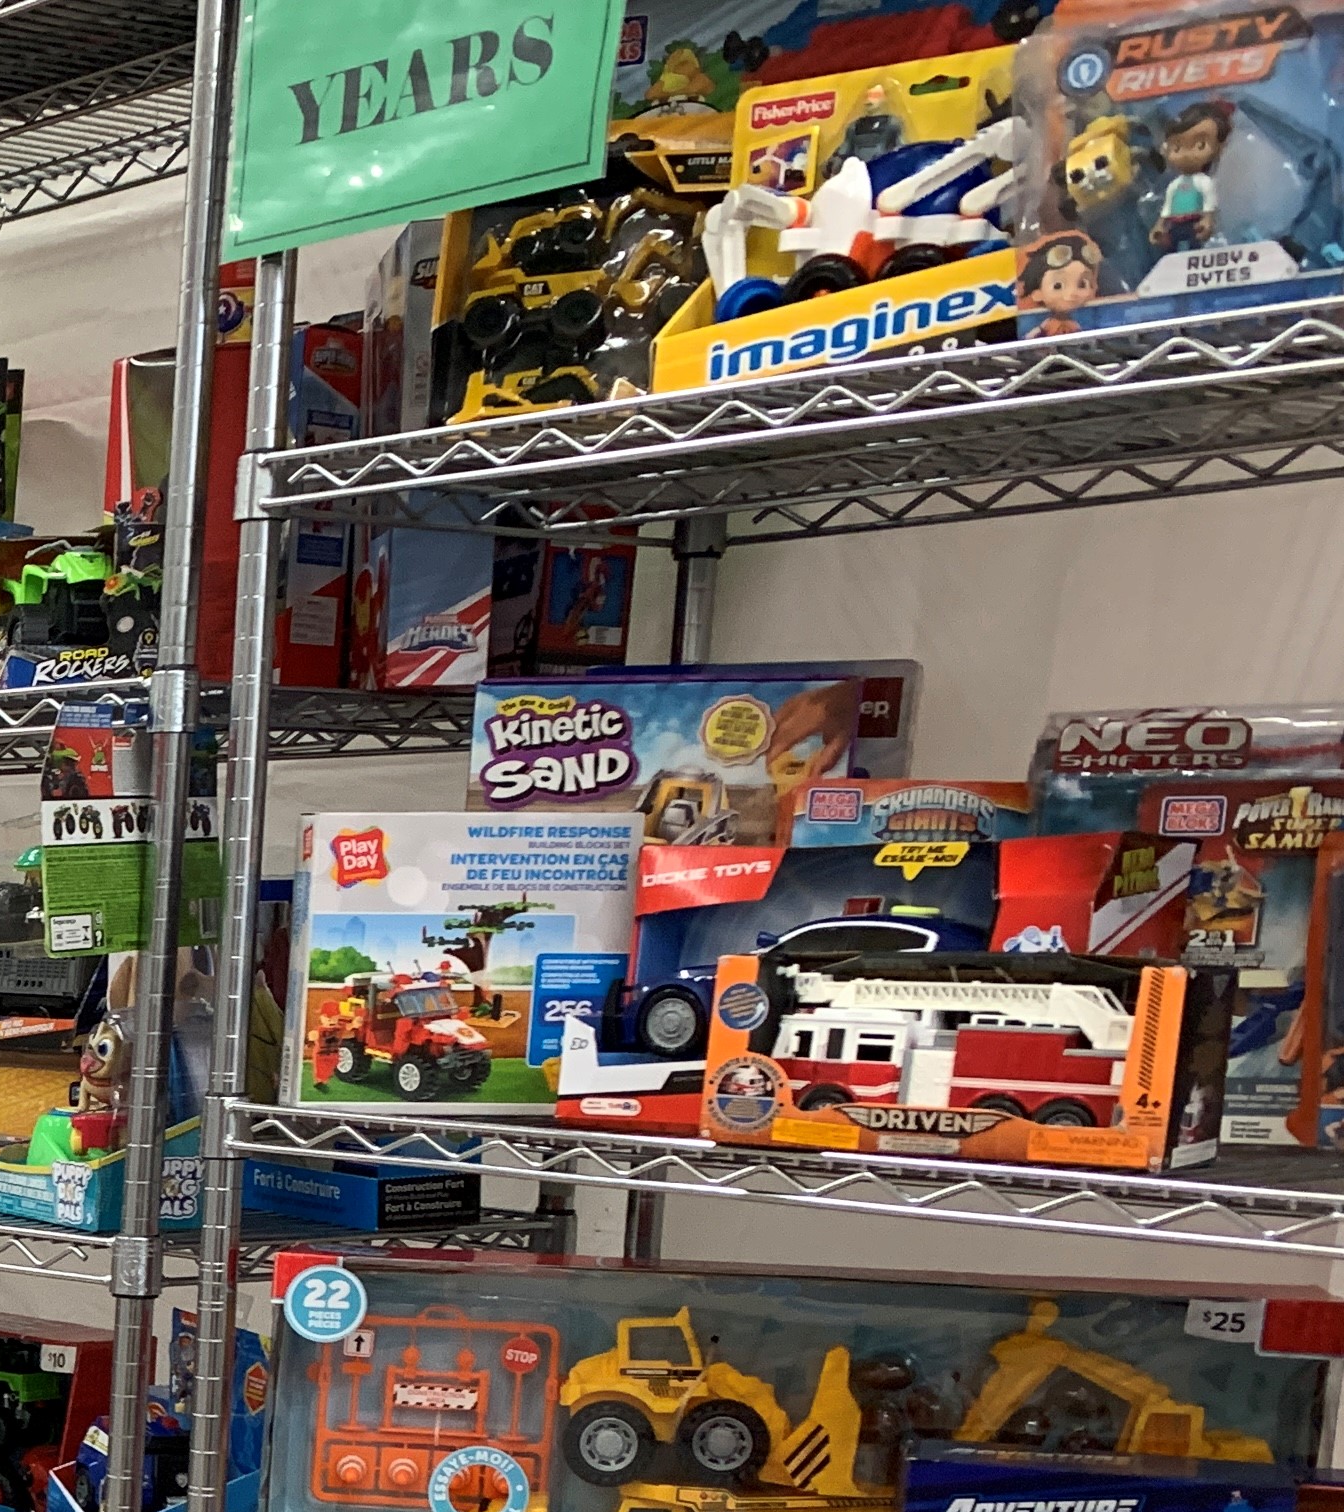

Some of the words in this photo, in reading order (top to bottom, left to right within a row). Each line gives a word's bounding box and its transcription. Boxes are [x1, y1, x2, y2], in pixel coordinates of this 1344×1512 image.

[1115, 12, 1291, 63] RUSTY
[287, 15, 555, 146] YEARS
[1114, 49, 1269, 95] RIVETS
[752, 97, 836, 123] Fisher-Price
[1185, 251, 1242, 271] RUBY
[1185, 266, 1252, 287] BYTES
[522, 282, 547, 296] CAT
[59, 646, 110, 662] ROAD
[33, 654, 131, 686] ROCKERS
[490, 703, 627, 751] Kinetic
[1058, 719, 1247, 753] NEO
[1060, 752, 1247, 768] SHIFTERS
[812, 792, 857, 808] MEGA
[1167, 801, 1220, 817] MEGA
[812, 805, 857, 821] BLOKS
[467, 826, 544, 839] WILDFIRE
[547, 826, 632, 839] RESPONSE
[1164, 815, 1219, 832] BLOKS
[339, 837, 380, 858] Play
[342, 853, 380, 873] Day
[450, 853, 570, 866] INTERVENTION
[574, 853, 595, 866] EN
[466, 869, 488, 881] DE
[490, 868, 526, 881] FEU
[642, 866, 709, 888] DICKIE
[712, 860, 772, 878] TOYS
[1135, 1093, 1162, 1109] 4+
[869, 1109, 973, 1134] DRIVEN
[55, 1162, 92, 1185] PUPPY
[286, 1175, 342, 1200] Construire
[384, 1181, 441, 1195] Construction
[301, 1279, 352, 1309] 22
[1202, 1310, 1247, 1333] $25
[46, 1352, 68, 1370] $10
[504, 1347, 538, 1366] STOP
